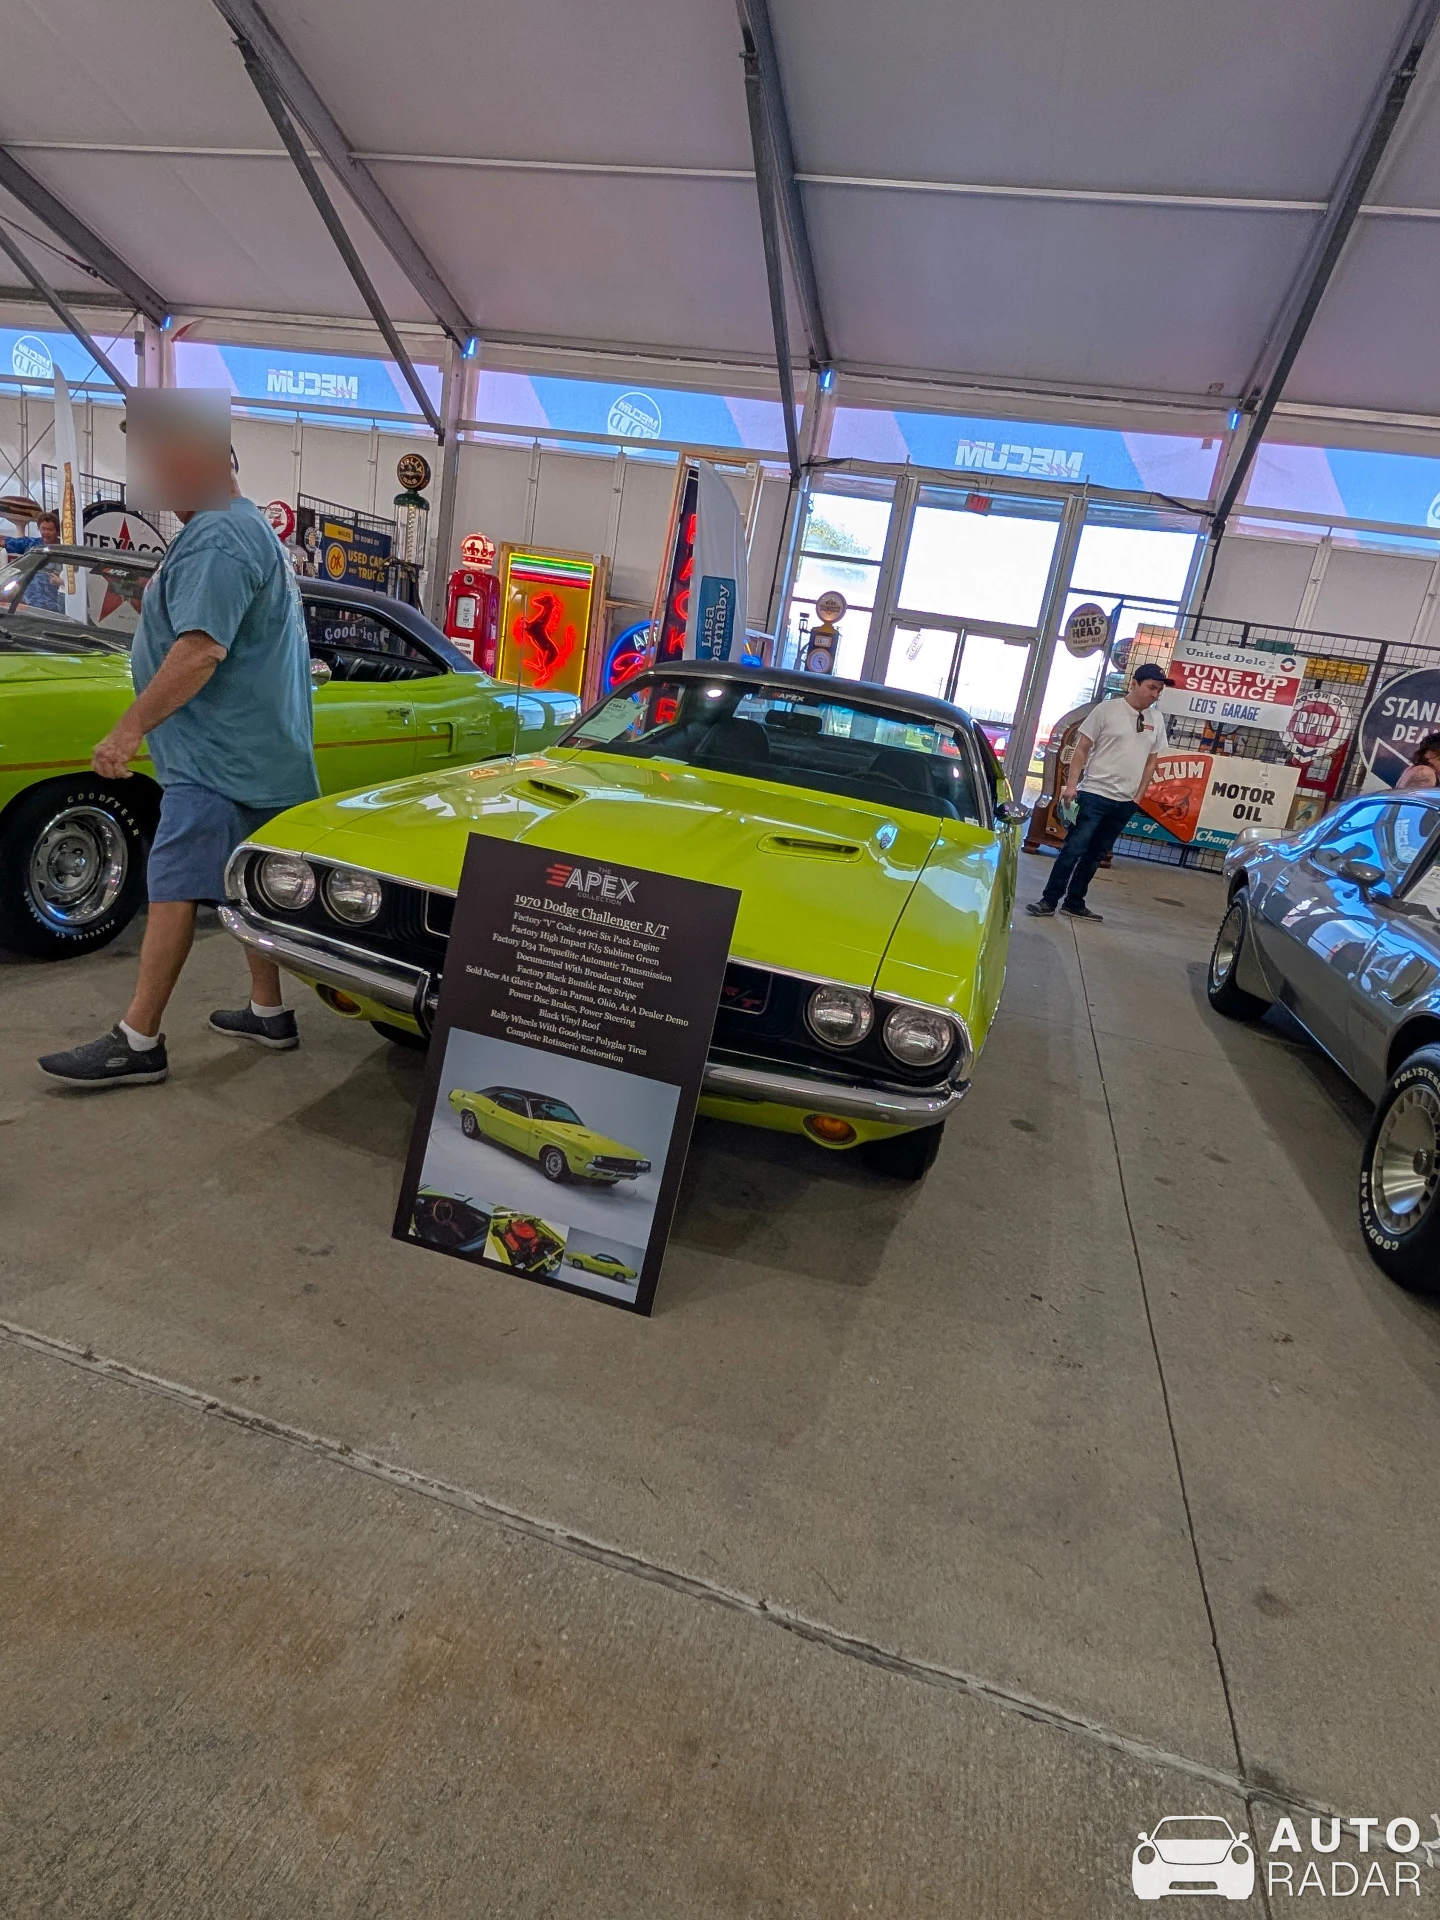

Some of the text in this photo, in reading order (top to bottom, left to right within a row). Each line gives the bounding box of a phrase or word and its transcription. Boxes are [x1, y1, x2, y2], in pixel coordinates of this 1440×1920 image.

[330, 551, 343, 570] OK
[347, 550, 367, 565] USED
[701, 606, 715, 648] Lisa
[1072, 626, 1102, 639] HEAD
[1185, 647, 1231, 662] United
[1181, 663, 1288, 689] TUNE-UP
[1185, 677, 1277, 702] SERVICE
[1188, 697, 1261, 722] LEO'S GARAGE
[1293, 711, 1335, 738] RPM
[1392, 723, 1440, 745] DEA
[1211, 782, 1276, 806] MOTOR
[67, 792, 140, 837] GOODYEAR
[1142, 822, 1160, 834] of
[1232, 803, 1263, 823] OIL
[564, 868, 640, 904] APEX
[514, 893, 669, 936] 1970 Dodge Challenger R/T
[510, 924, 539, 938] Factory
[539, 930, 558, 942] High
[559, 935, 586, 948] Impact
[602, 945, 634, 959] Sublime
[635, 953, 659, 965] Green
[513, 911, 541, 926] Factory
[555, 921, 575, 933] Code
[599, 931, 611, 941] Six
[612, 934, 631, 945] Pack
[632, 939, 659, 952] Engine
[465, 964, 482, 975] Sold
[482, 968, 500, 979] New
[499, 973, 509, 982] At
[542, 897, 579, 917] Dodge
[568, 990, 595, 1004] Parma,
[596, 997, 617, 1010] Ohio,
[618, 1002, 629, 1011] As
[629, 1005, 636, 1014] A
[638, 1007, 664, 1020] Dealer
[664, 1013, 688, 1026] Demo
[492, 932, 520, 947] Factory
[579, 954, 619, 969] Automatic
[620, 962, 671, 982] Transmission
[515, 951, 643, 989] Documented With Broadcast Sheet
[516, 964, 636, 1000] Factory Black Bumble Bee Stripe
[508, 987, 635, 1028] Power Disc Brakes, Power Steering
[538, 1008, 601, 1030] Black Vinyl Roof
[490, 1008, 647, 1055] Rally Wheels With Goodyear Polyglas Tires
[505, 1026, 541, 1041] Complete
[579, 1044, 623, 1063] Restoration
[1394, 1066, 1440, 1092] POLYSTEE
[1361, 1171, 1400, 1252] GOODYEAR
